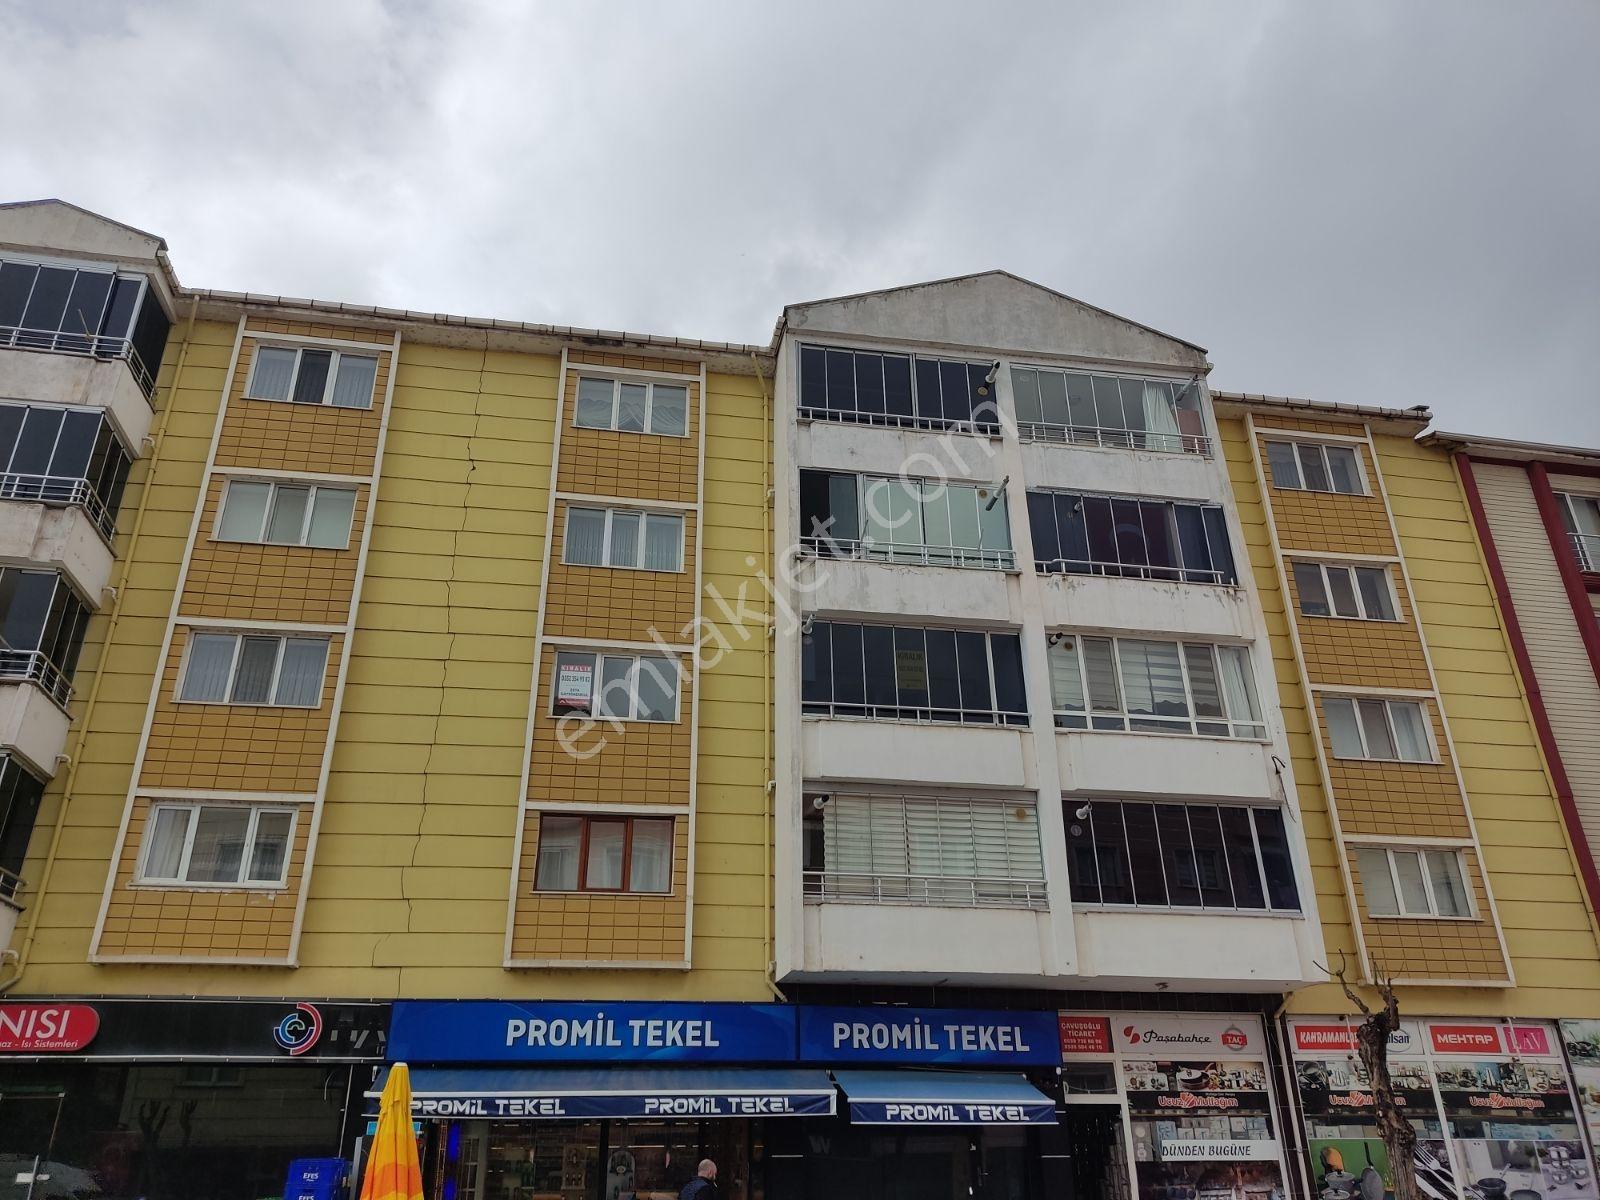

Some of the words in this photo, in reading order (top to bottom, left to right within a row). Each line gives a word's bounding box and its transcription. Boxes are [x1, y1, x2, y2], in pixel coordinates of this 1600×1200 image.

[505, 1012, 622, 1046] PROMİL
[628, 1020, 719, 1047] TEKEL
[833, 1017, 939, 1050] PROMİL
[943, 1025, 1031, 1052] TEKEL
[1142, 1029, 1211, 1045] Paşabahçe
[34, 1039, 79, 1048] Sistemleri
[1227, 1036, 1242, 1045] TAÇ
[1437, 1034, 1494, 1045] MEHTAP
[1508, 1031, 1541, 1050] LAV
[495, 1098, 565, 1115] TEKEL
[728, 1096, 795, 1113] TEKEL
[965, 1105, 1030, 1121] TEKEL
[1162, 1144, 1205, 1156] DÜNDEN
[1208, 1144, 1251, 1156] BUGÜNE
